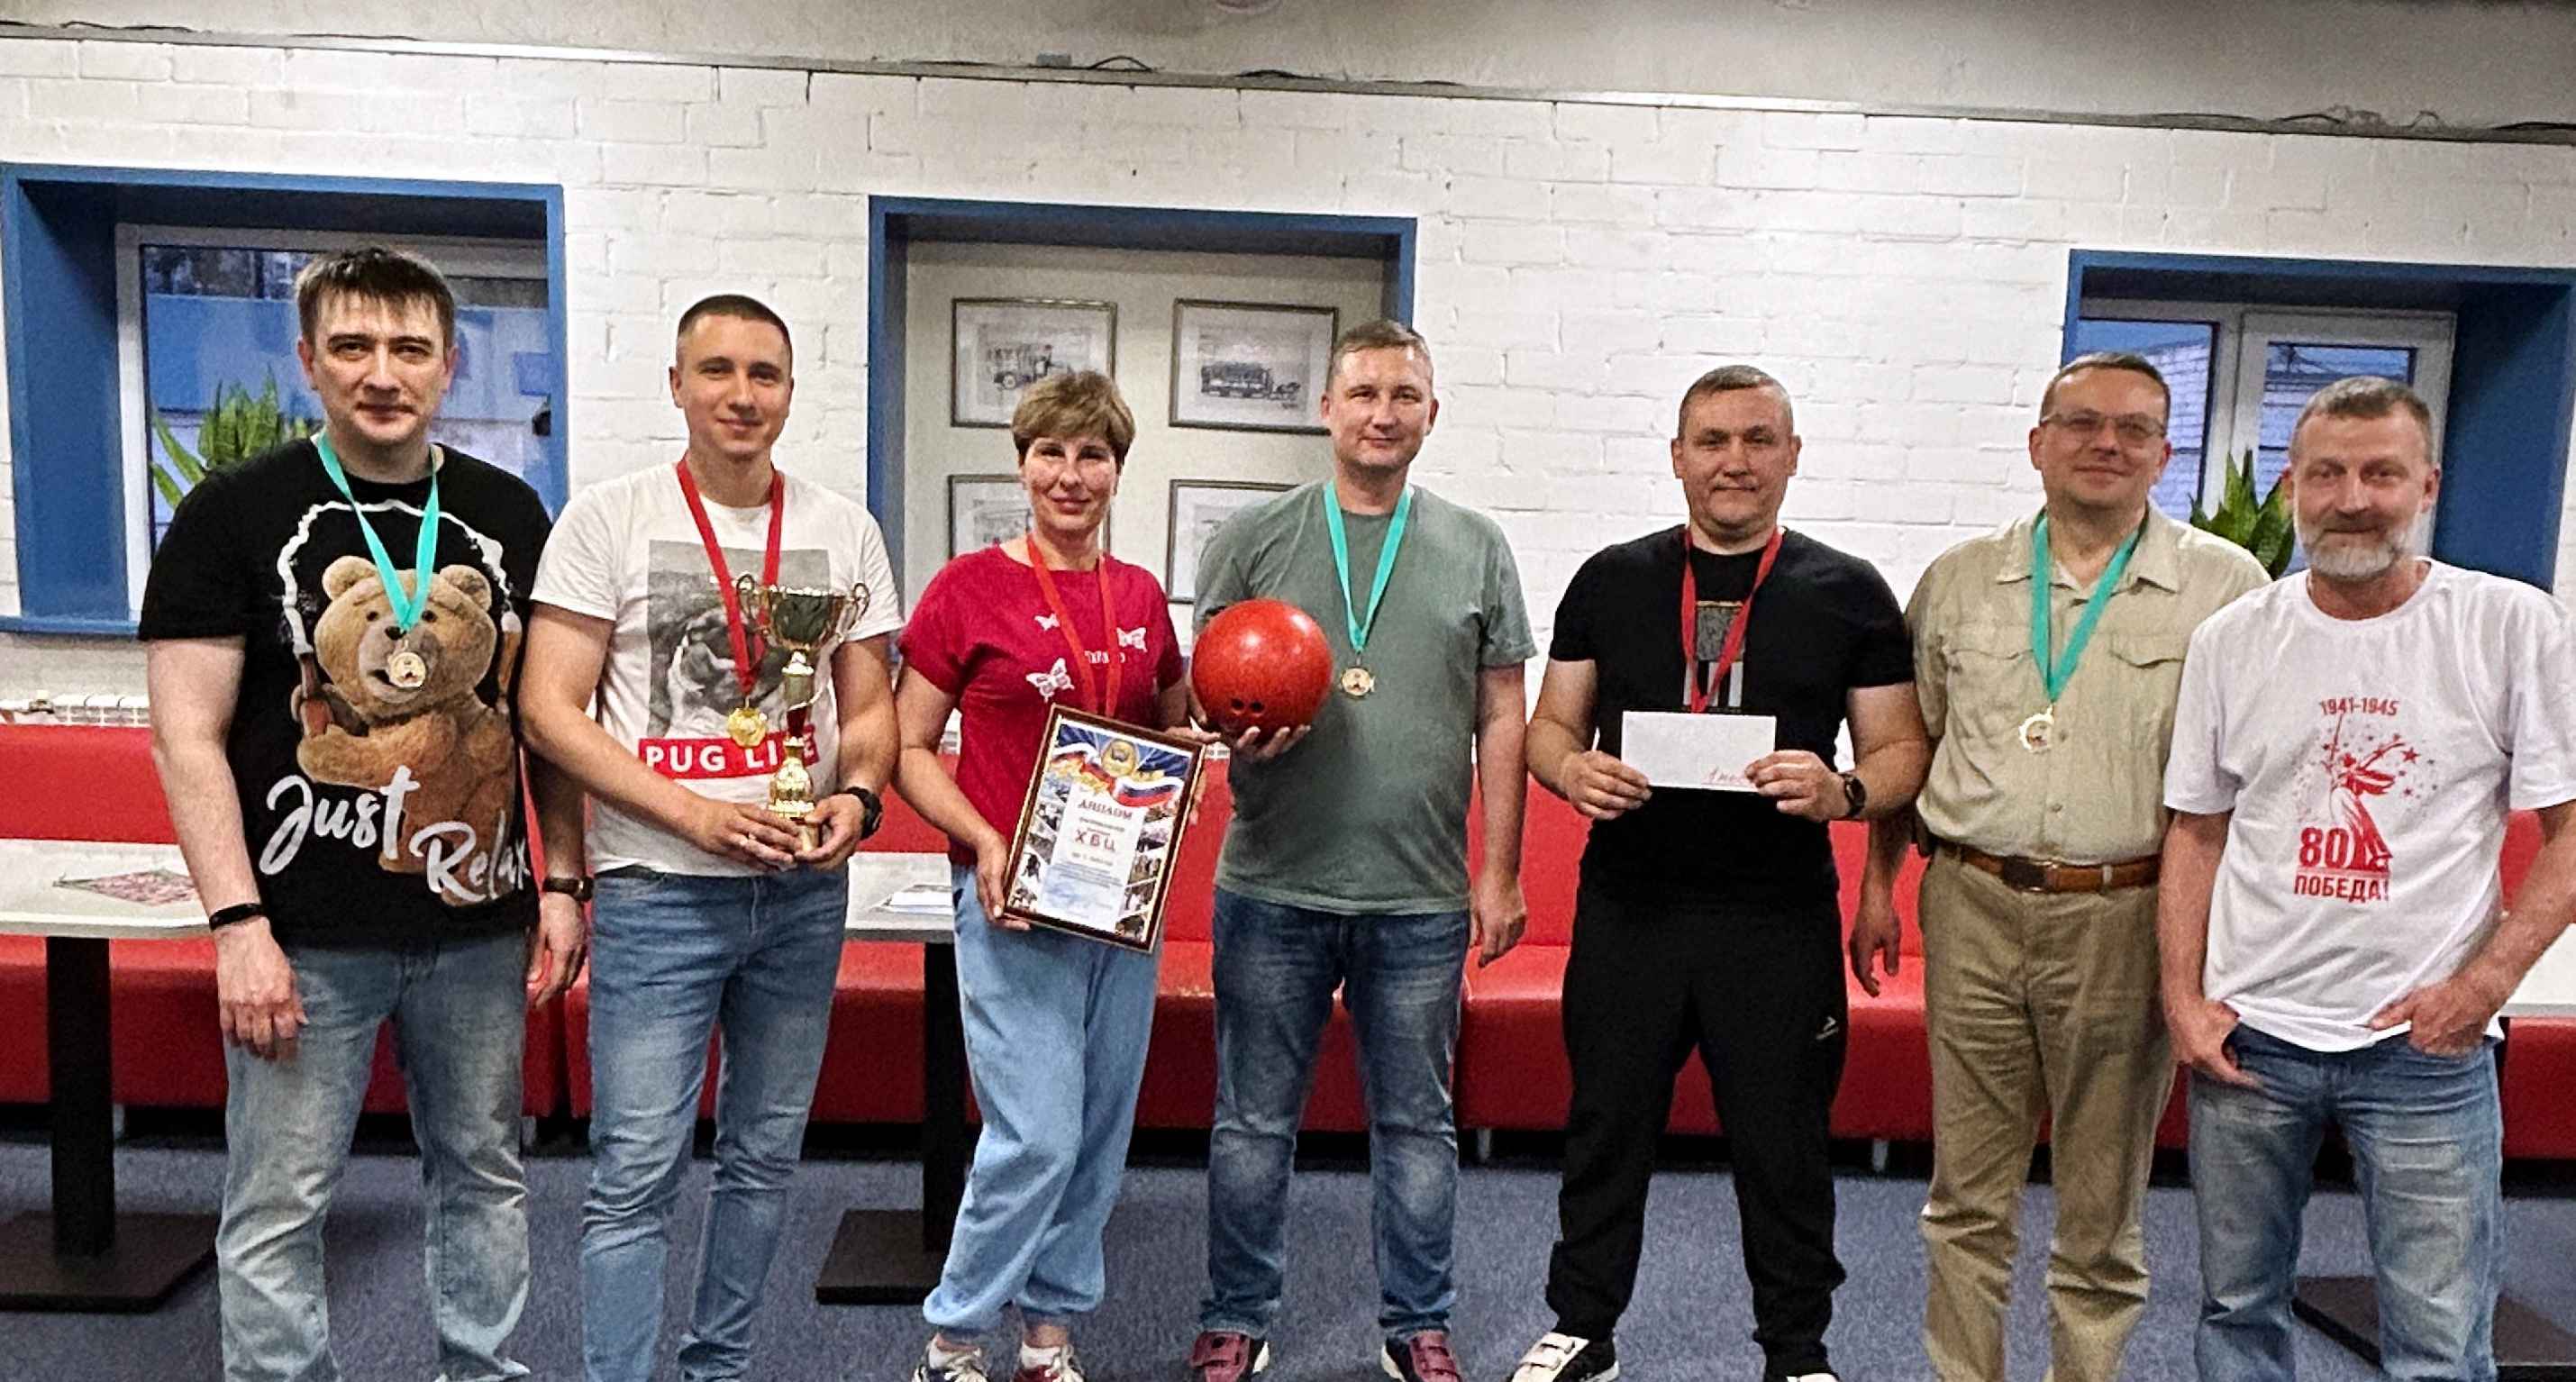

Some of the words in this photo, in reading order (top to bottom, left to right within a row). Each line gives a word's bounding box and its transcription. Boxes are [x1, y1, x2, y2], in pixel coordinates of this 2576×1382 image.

[2320, 697, 2399, 716] 1941-1945
[645, 746, 725, 772] PUG
[743, 740, 815, 770] LIE
[259, 765, 421, 875] Just
[409, 809, 532, 902] Relax
[2299, 827, 2349, 869] 80
[2294, 875, 2390, 904] ПОБЕДА!
